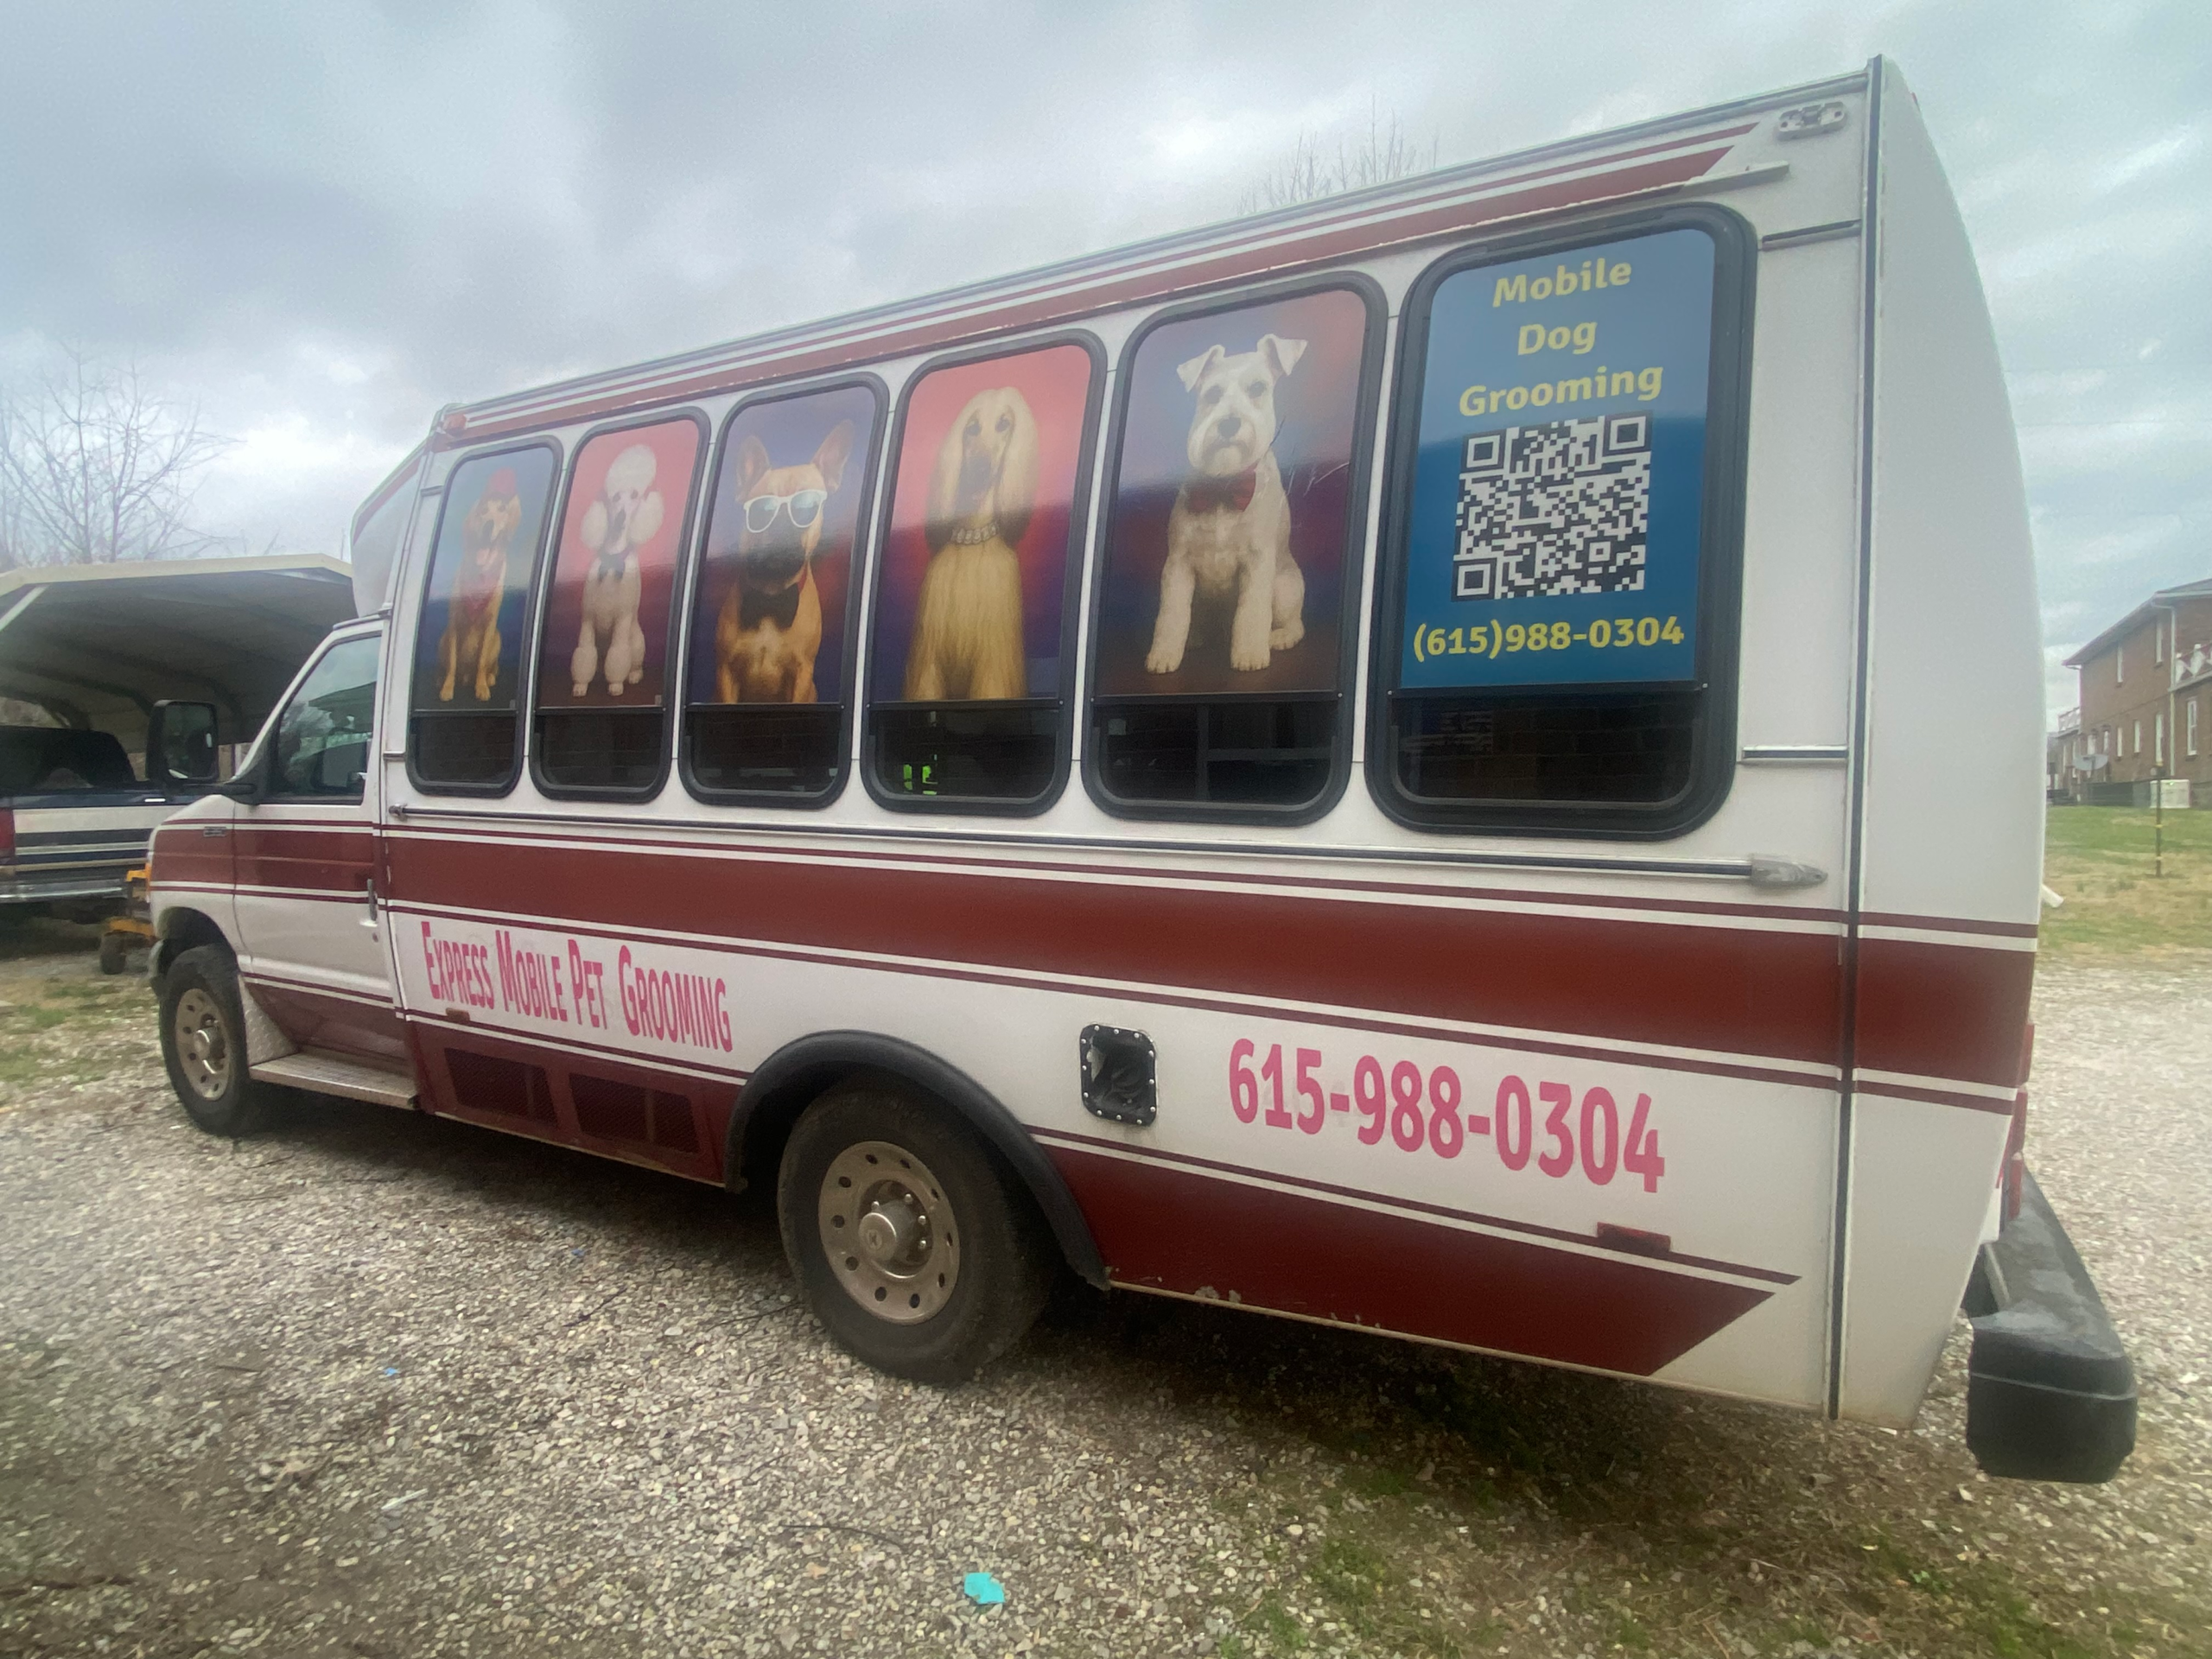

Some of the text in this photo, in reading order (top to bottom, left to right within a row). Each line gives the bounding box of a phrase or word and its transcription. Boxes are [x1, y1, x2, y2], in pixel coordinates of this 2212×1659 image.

[1492, 257, 1632, 308] Mobile
[1517, 321, 1597, 355] Dog
[1459, 365, 1663, 416] Grooming
[1413, 616, 1684, 662] (615)988-0304
[421, 921, 733, 1052] EXPRESS MOBILE PET GROOMING
[1229, 1038, 1665, 1192] 615-988-0304
